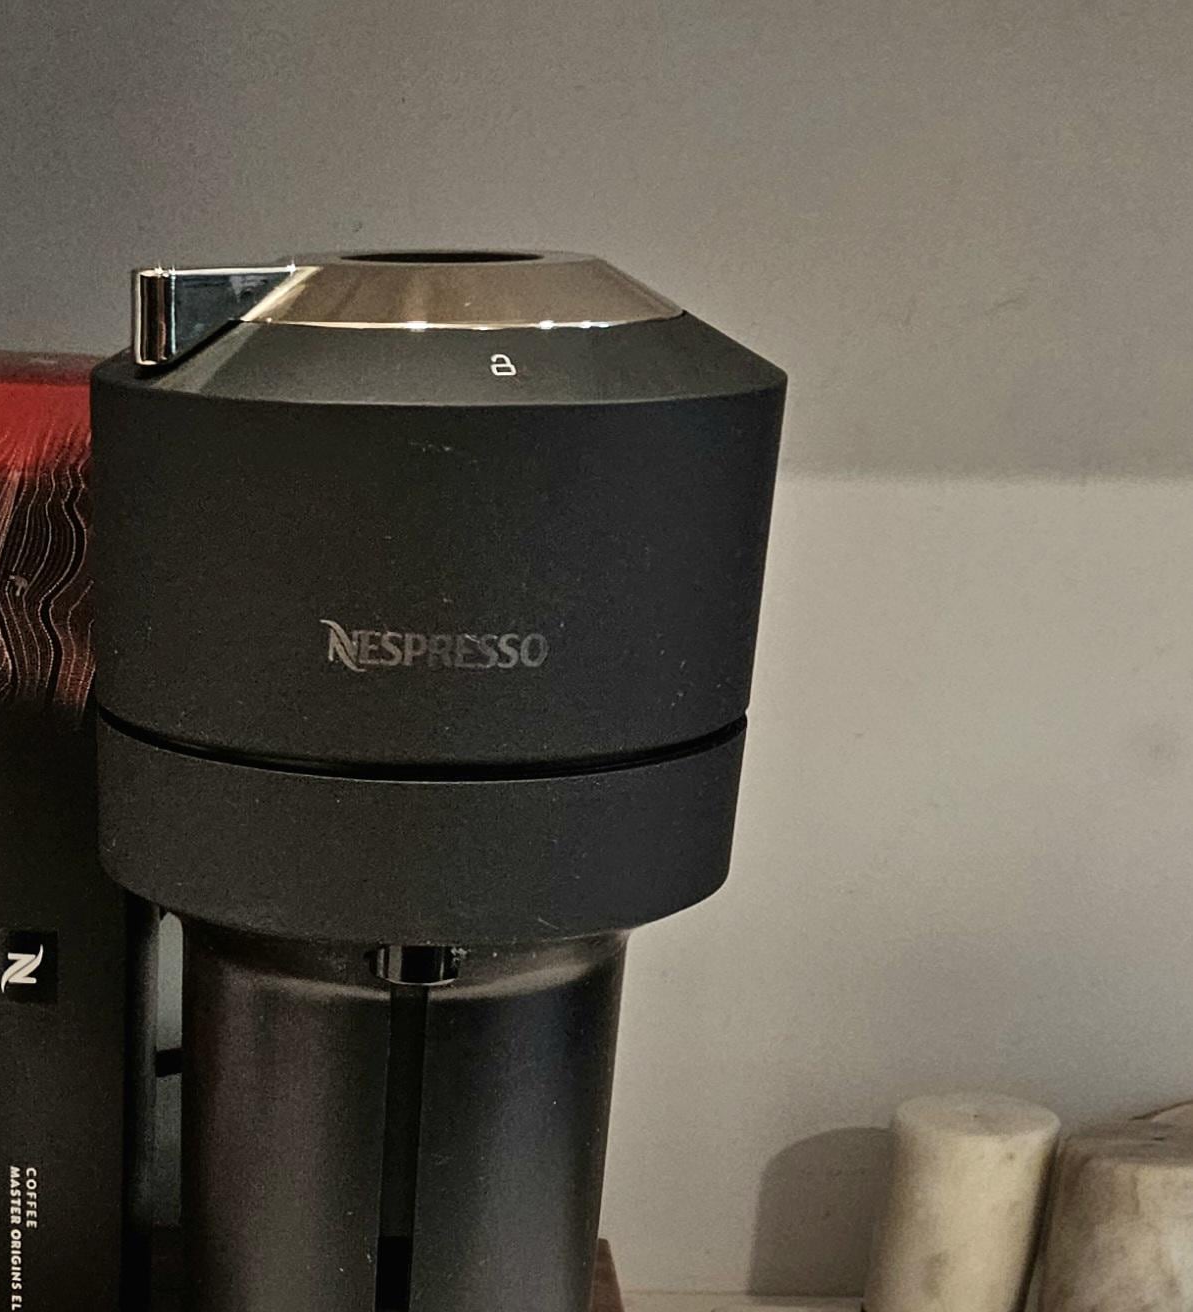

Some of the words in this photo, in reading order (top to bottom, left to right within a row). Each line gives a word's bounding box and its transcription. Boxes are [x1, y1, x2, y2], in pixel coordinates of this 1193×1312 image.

[319, 618, 549, 673] NESPRESSO
[9, 1165, 22, 1225] MASTER
[25, 1166, 38, 1229] COFFEE
[10, 1228, 23, 1290] ORIGINS
[11, 1294, 23, 1311] EL
